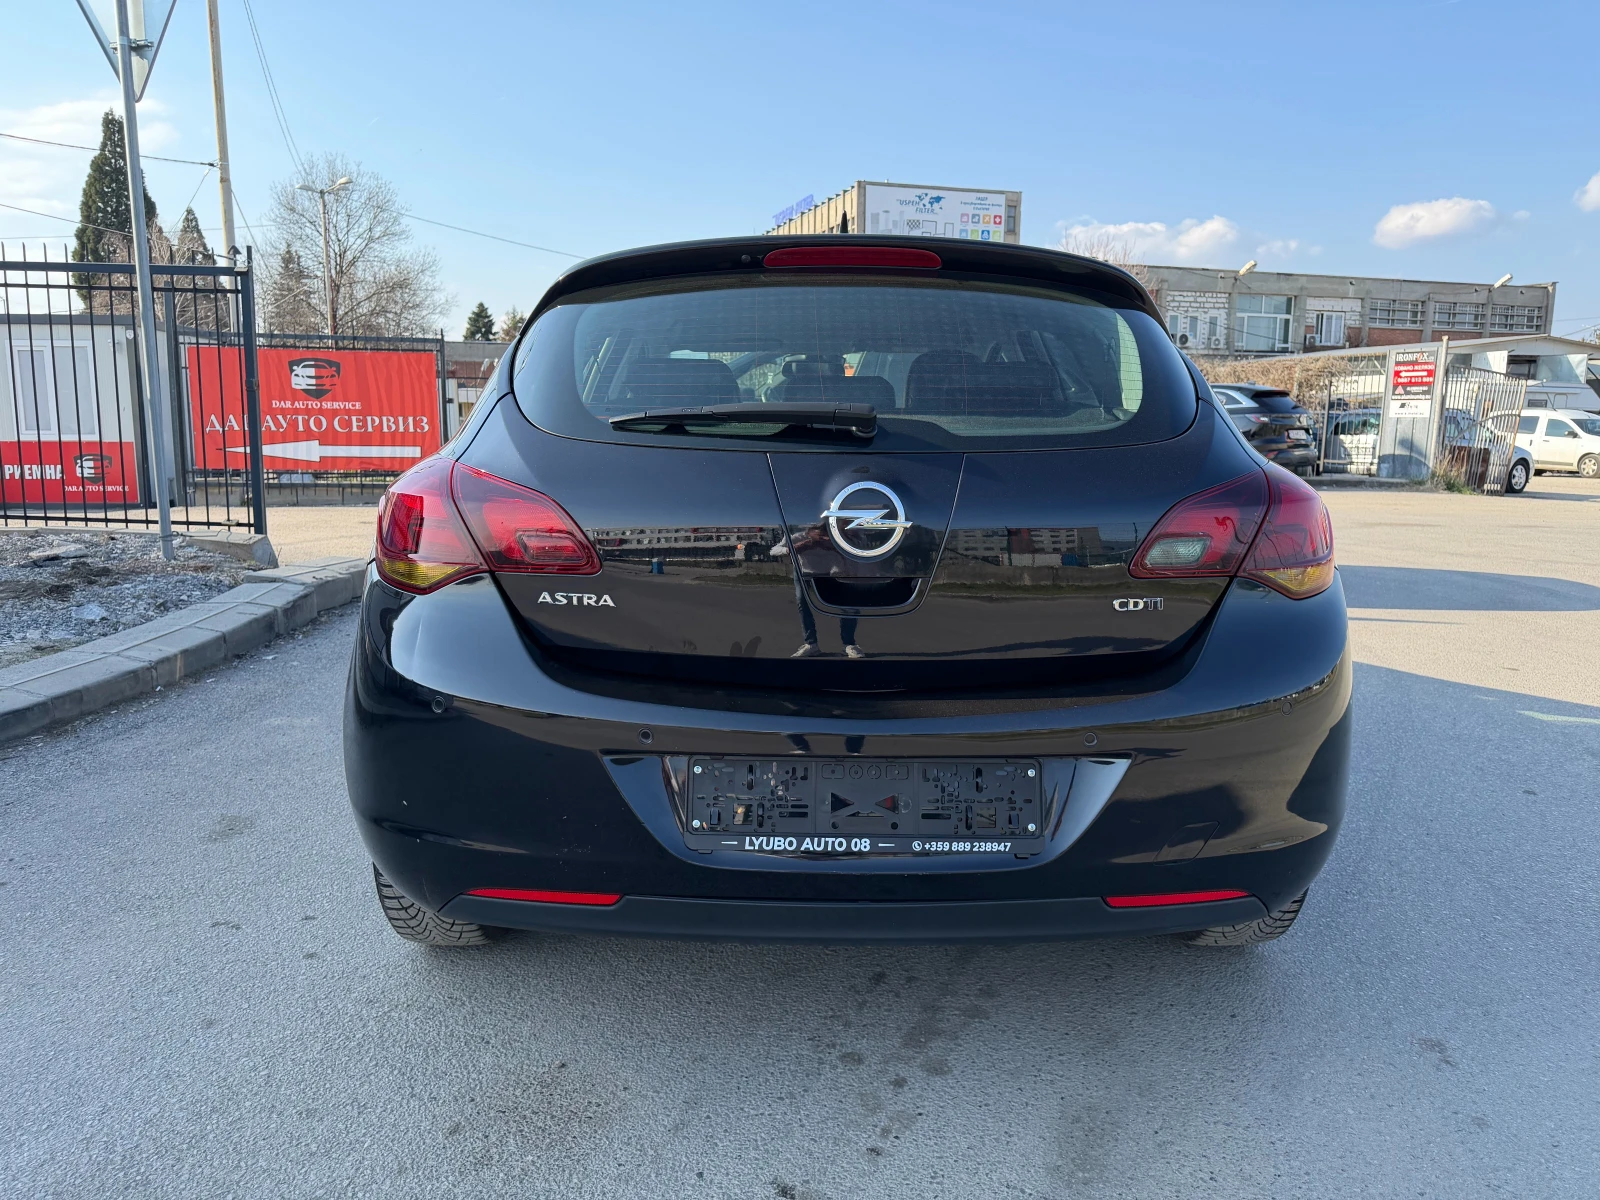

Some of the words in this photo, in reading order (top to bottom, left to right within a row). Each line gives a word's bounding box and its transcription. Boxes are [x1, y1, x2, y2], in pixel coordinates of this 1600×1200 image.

[272, 400, 292, 409] DAR
[293, 400, 320, 409] AUTO
[321, 401, 362, 410] SERVICE
[261, 414, 328, 433] АУТО
[333, 415, 430, 433] СЕРВИЗ
[1, 464, 66, 480] РИЕМНА
[537, 591, 617, 608] ASTRA
[1112, 597, 1164, 611] CDTI
[744, 836, 797, 851] LYUBO
[800, 837, 847, 851] AUTO
[850, 838, 871, 852] 08
[924, 842, 950, 851] +359
[951, 842, 971, 851] 889
[972, 842, 1012, 852] 238947
